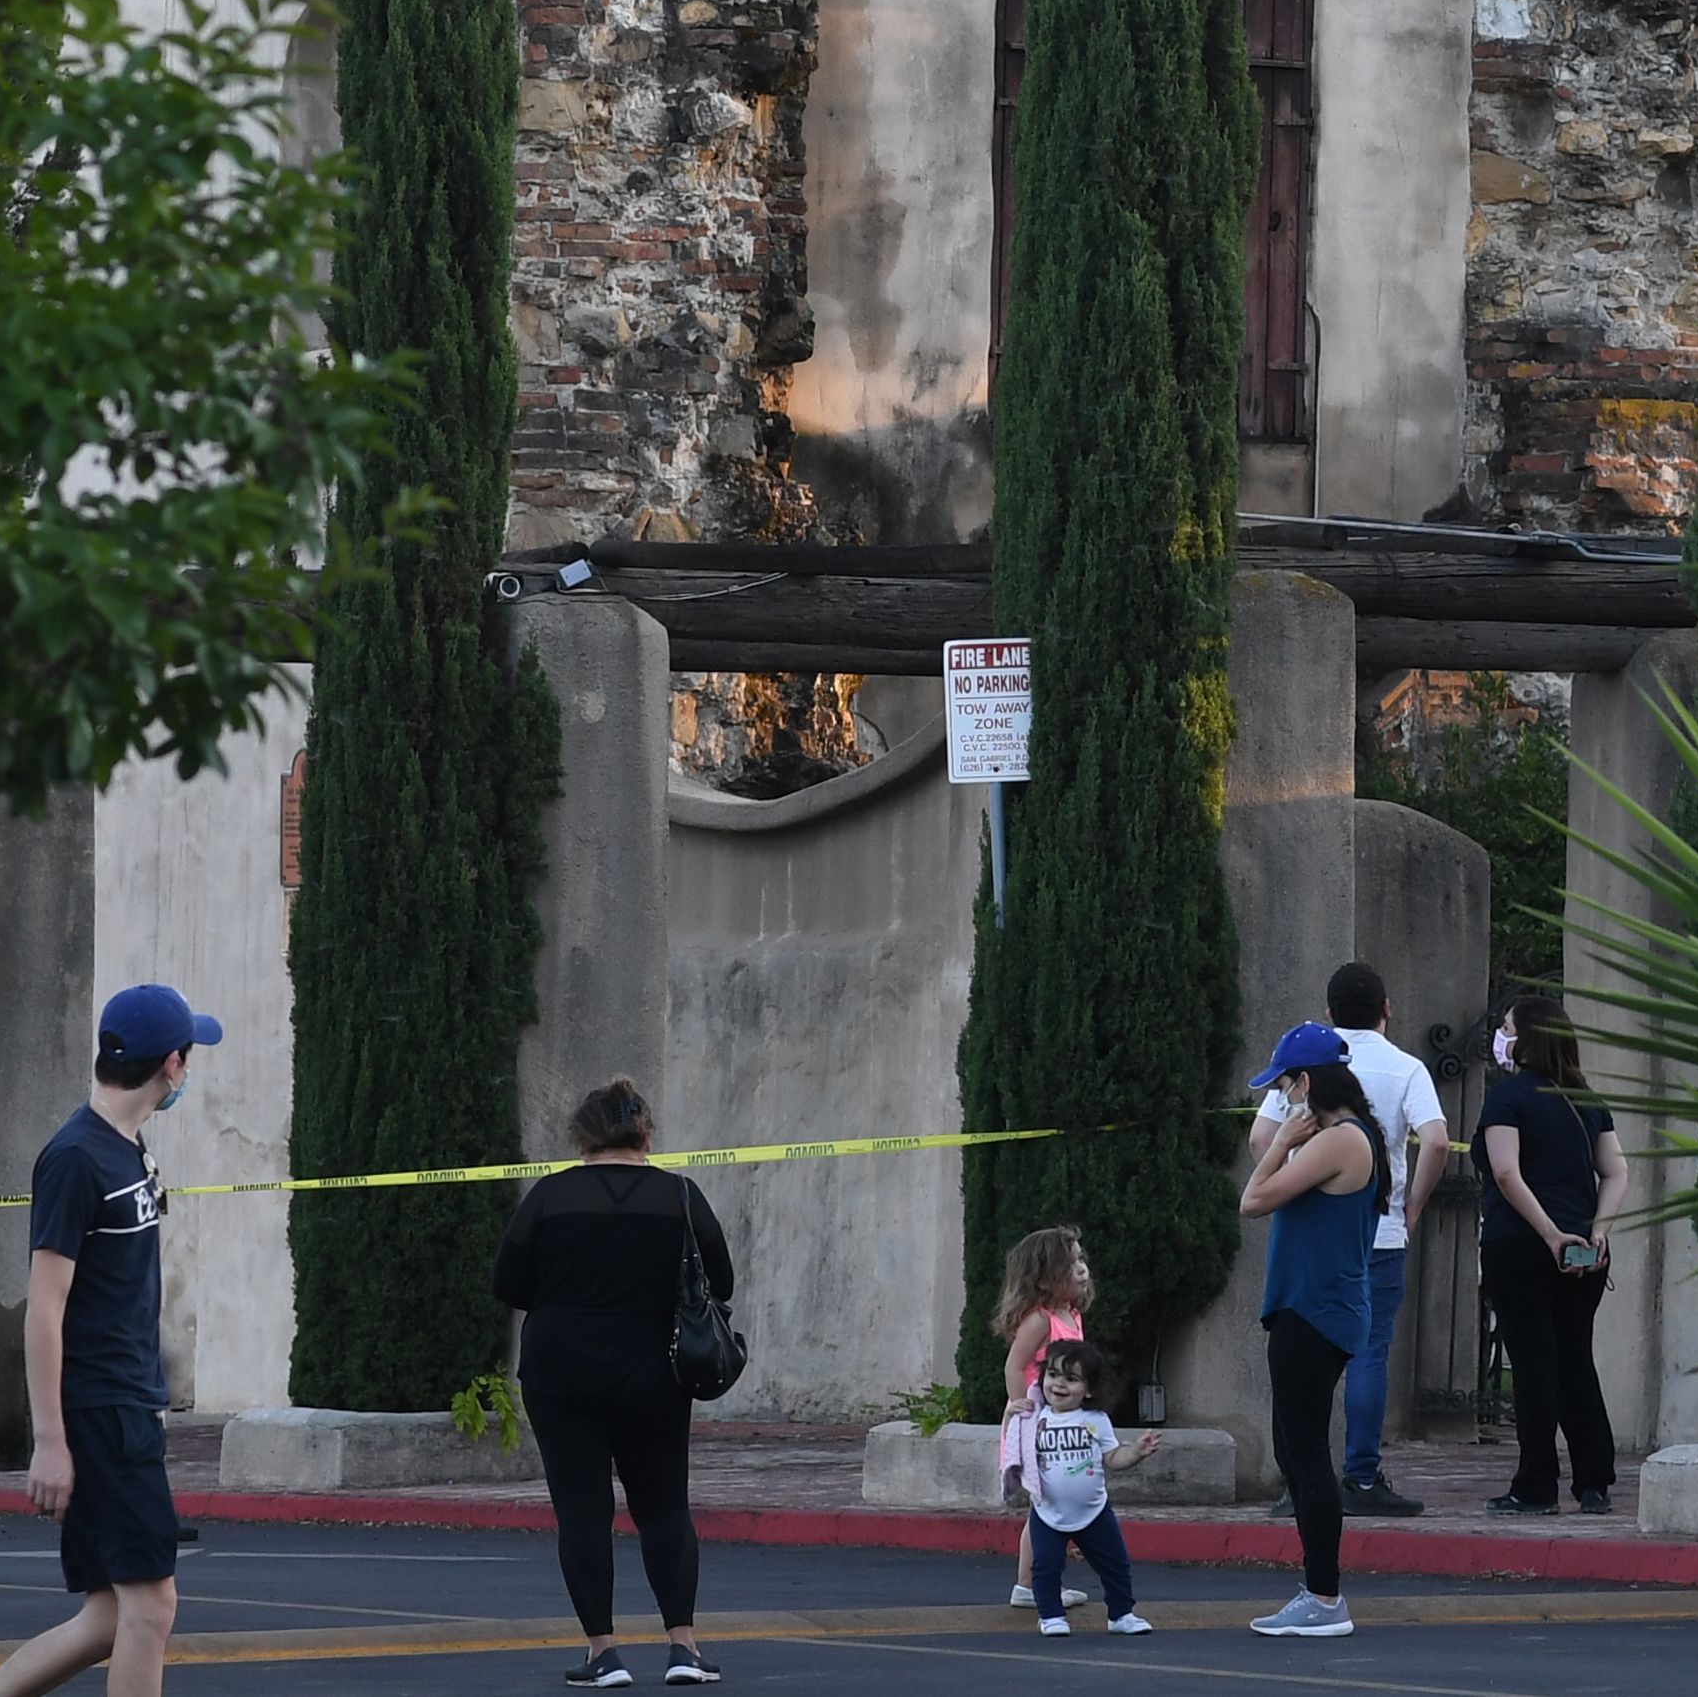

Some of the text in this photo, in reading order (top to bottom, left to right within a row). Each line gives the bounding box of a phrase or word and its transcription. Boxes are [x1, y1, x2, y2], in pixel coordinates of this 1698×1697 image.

[951, 646, 1031, 668] FIRE LANE
[954, 673, 1029, 694] NO PARKING
[955, 702, 1030, 715] TOW AWAY
[974, 717, 1013, 729] ZONE
[1038, 1428, 1090, 1450] MOANA
